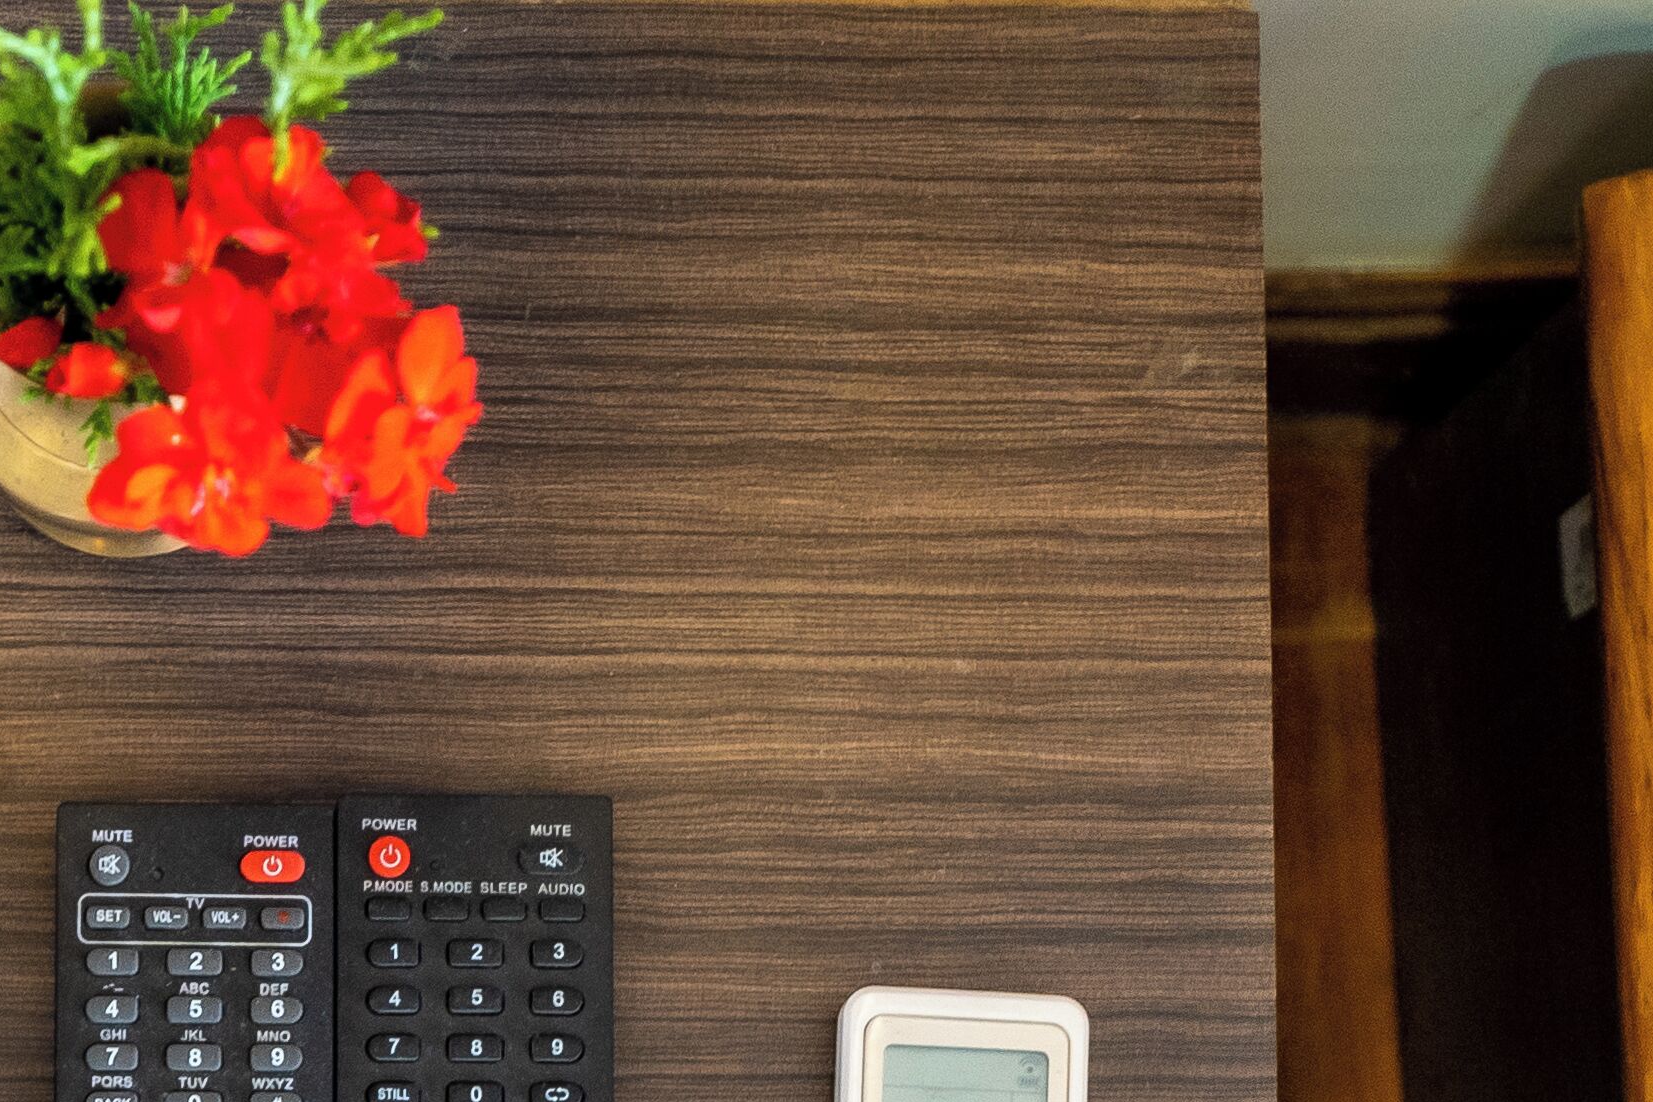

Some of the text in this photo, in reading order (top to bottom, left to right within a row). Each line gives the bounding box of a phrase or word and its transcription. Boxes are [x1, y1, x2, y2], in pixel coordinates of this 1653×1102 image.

[362, 819, 416, 830] POWER
[531, 825, 570, 836] MUTE
[93, 830, 132, 842] MUTE
[244, 835, 298, 847] POWER
[364, 880, 585, 895] P.MODE S.MODE SLEEP AUDIO
[186, 897, 205, 911] TV
[97, 910, 122, 922] SET
[391, 943, 564, 960] 1 2 3
[109, 952, 284, 970] 1 2 3
[180, 982, 288, 995] ABC DEF
[389, 989, 564, 1006] 4 5 6
[106, 1000, 284, 1017] 4 5 6
[100, 1029, 290, 1042] GHI JKL MNO
[389, 1038, 563, 1055] 7 8 9
[107, 1048, 284, 1066] 7 8 9
[92, 1076, 293, 1090] PQRS TUV WXYZ
[378, 1087, 482, 1102] STILL 0
